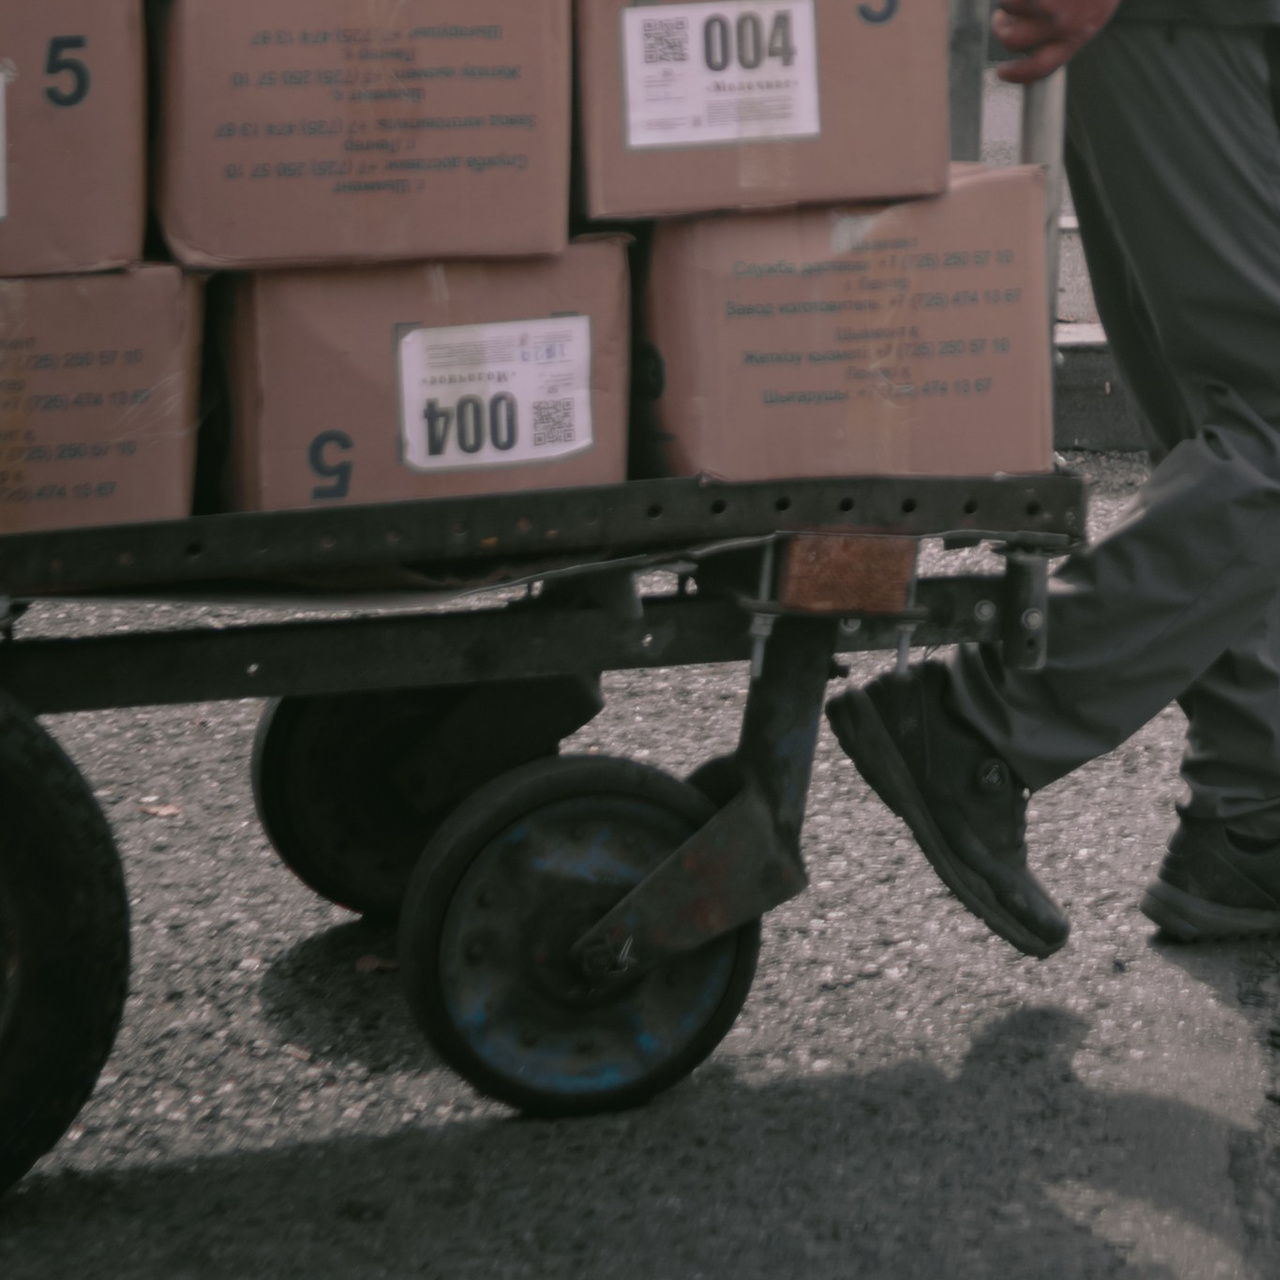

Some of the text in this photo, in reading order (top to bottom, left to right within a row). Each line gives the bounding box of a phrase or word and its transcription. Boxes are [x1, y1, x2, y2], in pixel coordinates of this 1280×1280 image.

[44, 36, 90, 106] 5
[704, 11, 796, 71] 004
[424, 391, 518, 455] 004
[309, 430, 355, 500] 5
